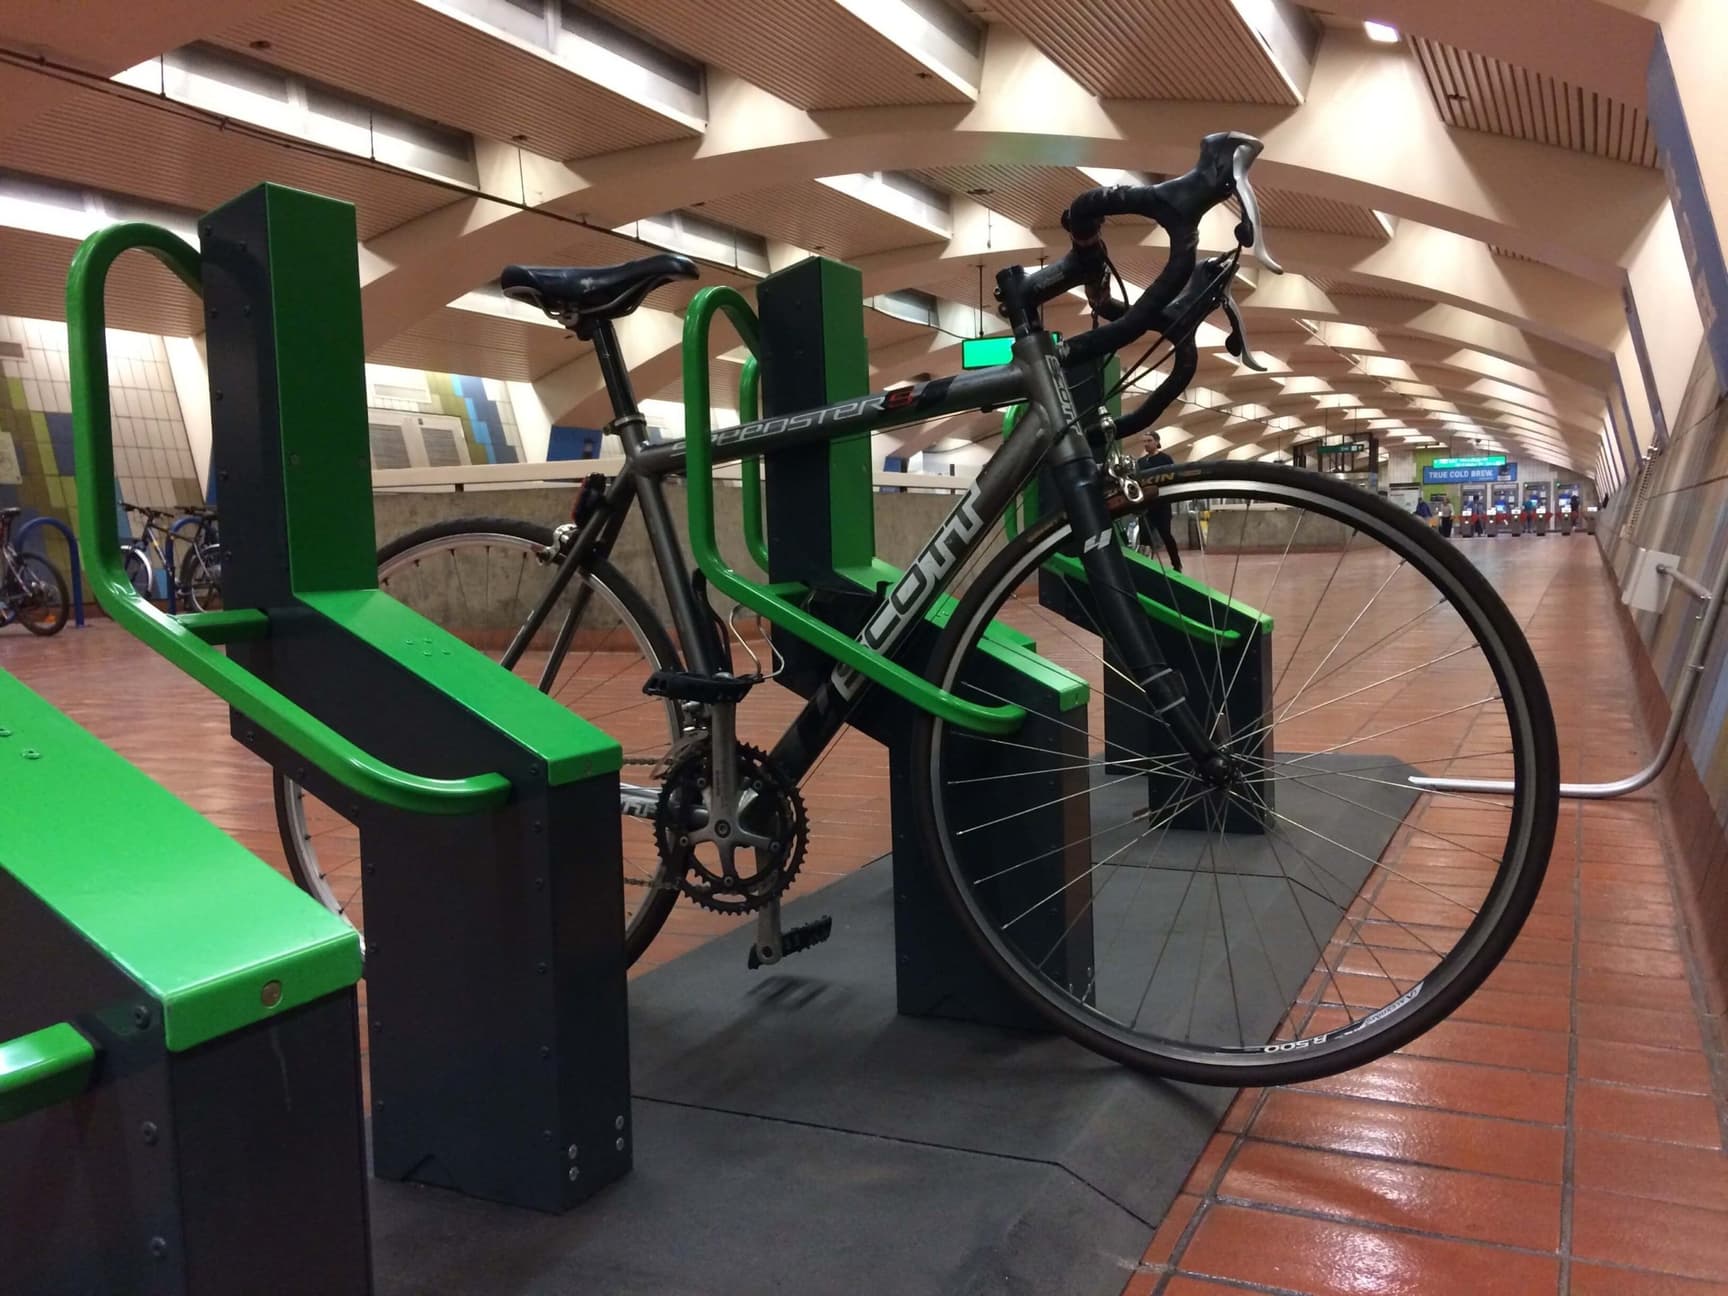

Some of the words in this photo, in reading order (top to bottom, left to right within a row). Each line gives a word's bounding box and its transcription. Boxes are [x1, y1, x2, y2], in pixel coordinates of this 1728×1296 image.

[1429, 471, 1448, 479] TRUE
[1449, 470, 1469, 478] COLD
[1470, 469, 1494, 478] BREW
